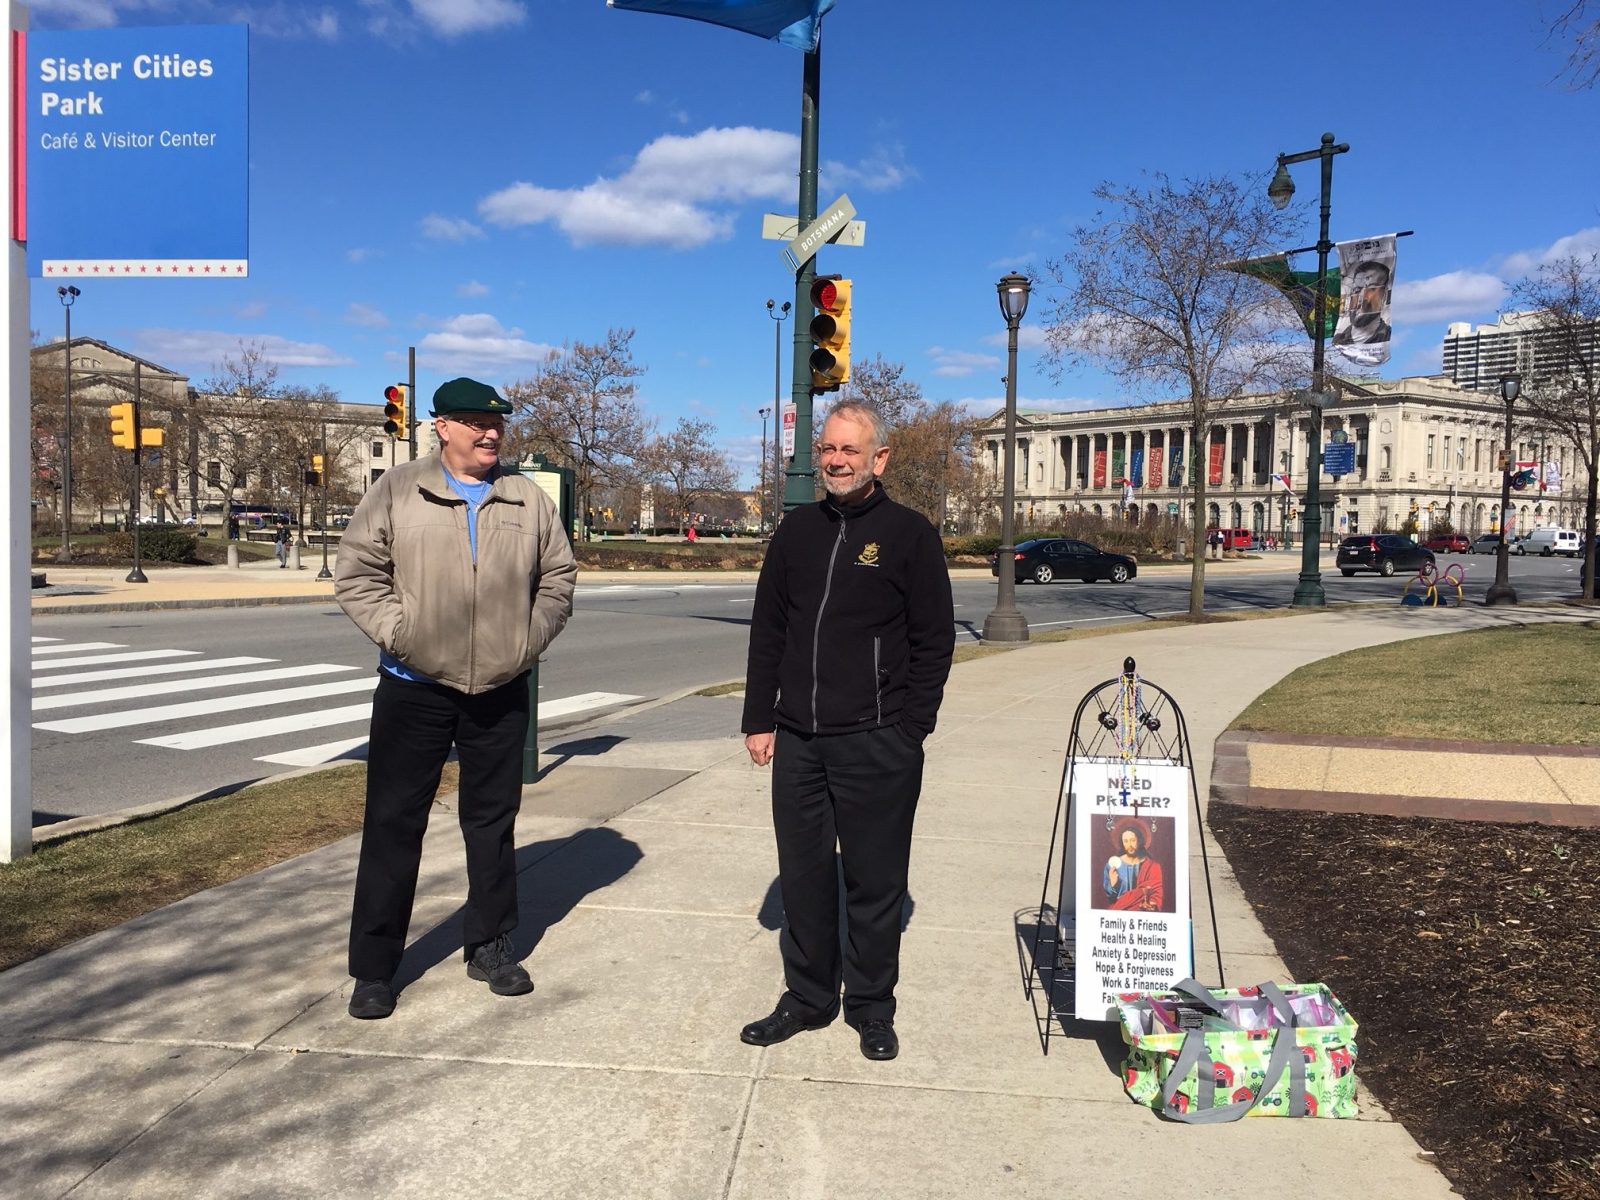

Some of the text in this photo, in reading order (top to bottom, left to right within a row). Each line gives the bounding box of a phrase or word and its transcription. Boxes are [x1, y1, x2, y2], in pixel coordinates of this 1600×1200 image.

[40, 54, 213, 82] Sister Cities
[41, 91, 103, 116] Park
[41, 131, 216, 149] Café & Visitor Center
[801, 209, 844, 252] BOTSWANA
[1108, 778, 1152, 790] NEED
[1100, 917, 1168, 932] Family & Friends
[1101, 931, 1167, 949] Health & Healing
[1092, 945, 1177, 963] Anxiety & Depression
[1095, 961, 1174, 978] Hope & Forgiveness
[1102, 976, 1169, 991] Work & Finances
